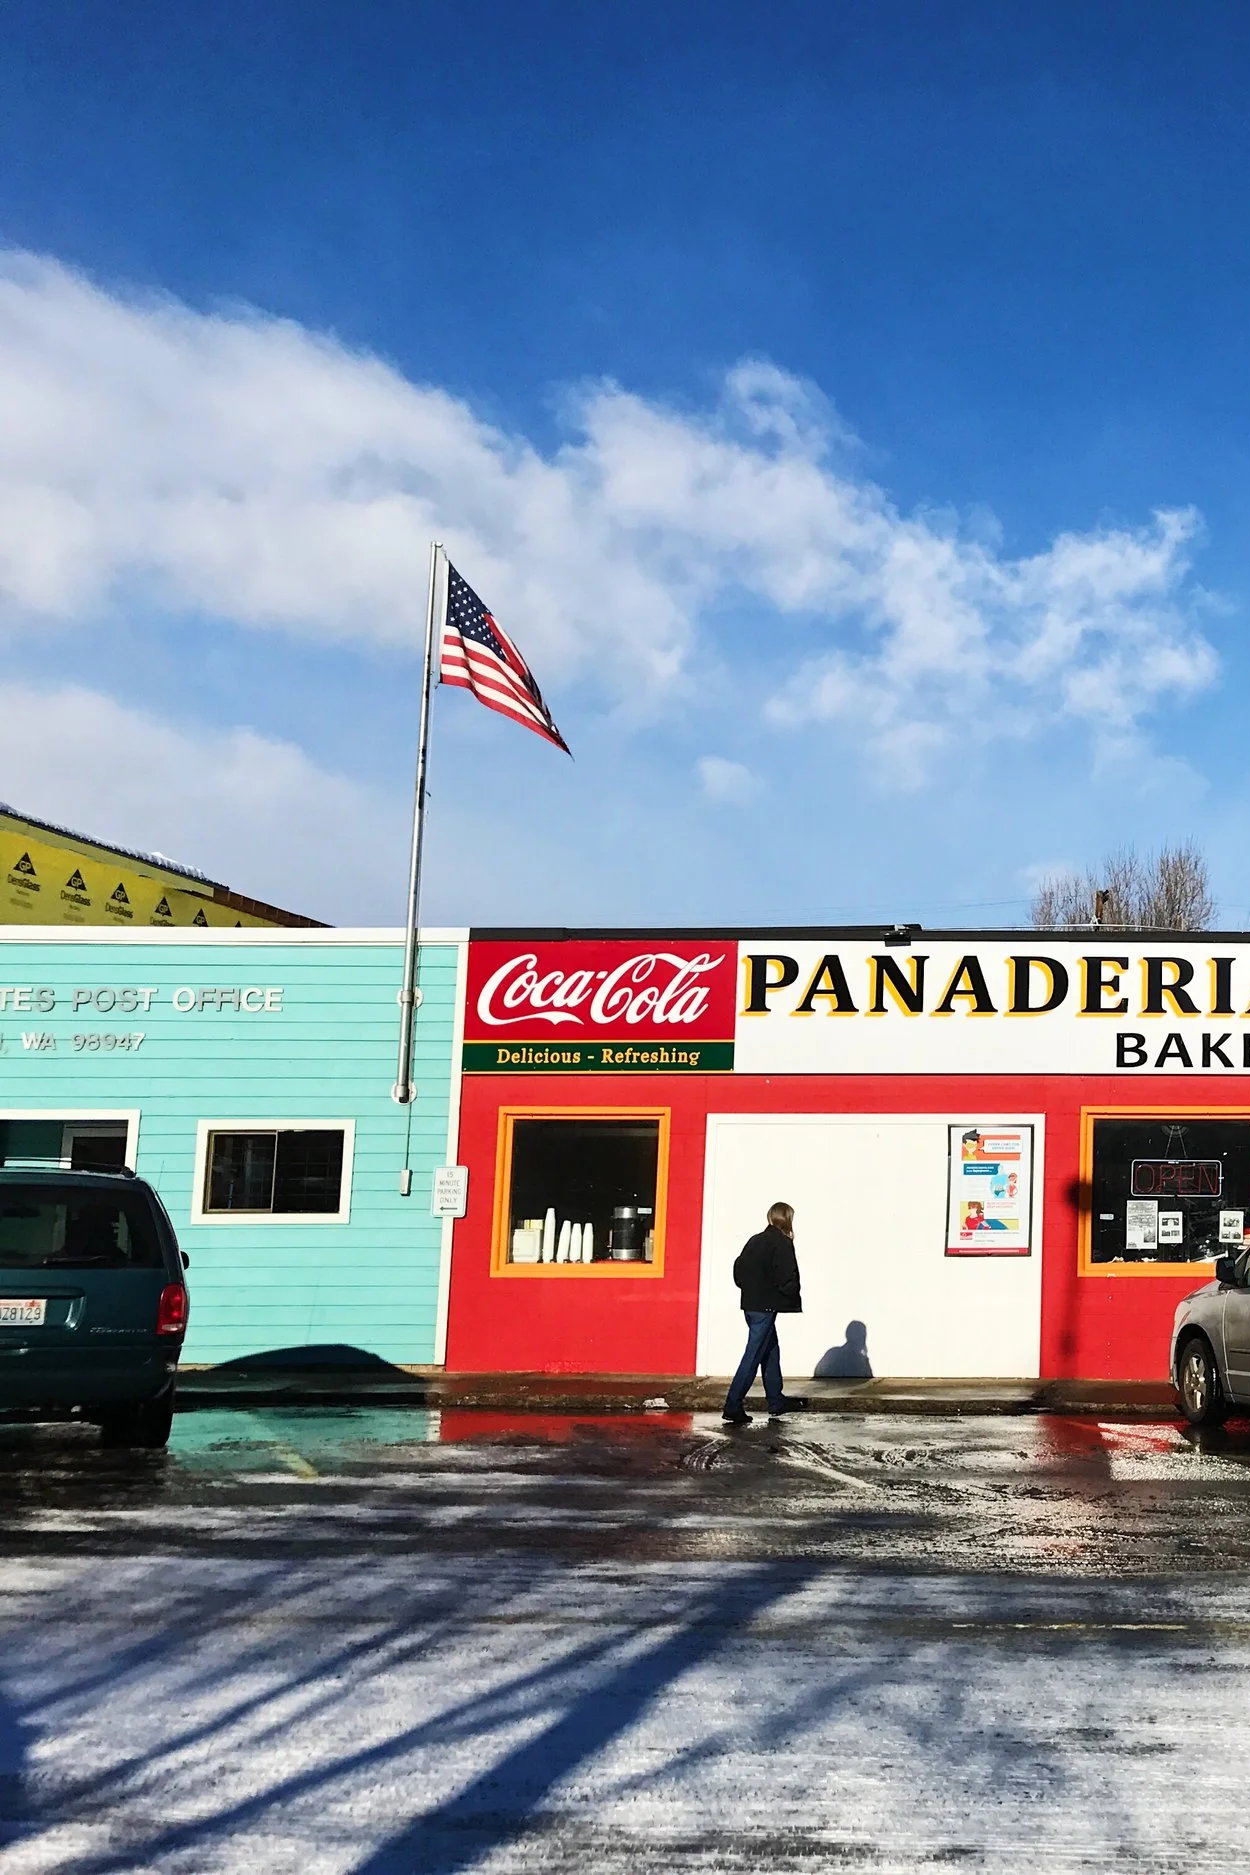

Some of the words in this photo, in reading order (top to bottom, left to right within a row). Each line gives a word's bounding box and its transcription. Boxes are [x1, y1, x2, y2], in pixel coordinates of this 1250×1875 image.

[18, 860, 32, 871] GP
[70, 876, 83, 887] GP
[60, 890, 92, 906] DensGlass
[115, 890, 126, 900] GP
[477, 953, 726, 1025] Coca-Cola
[72, 987, 159, 1013] POST
[172, 987, 285, 1013] OFFICE
[21, 1032, 57, 1051] WA
[72, 1032, 147, 1052] 98947
[497, 1048, 581, 1064] Delicious
[601, 1047, 701, 1066] Refreshing
[1135, 1163, 1219, 1194] OPEN
[0, 1307, 42, 1320] Z8129
